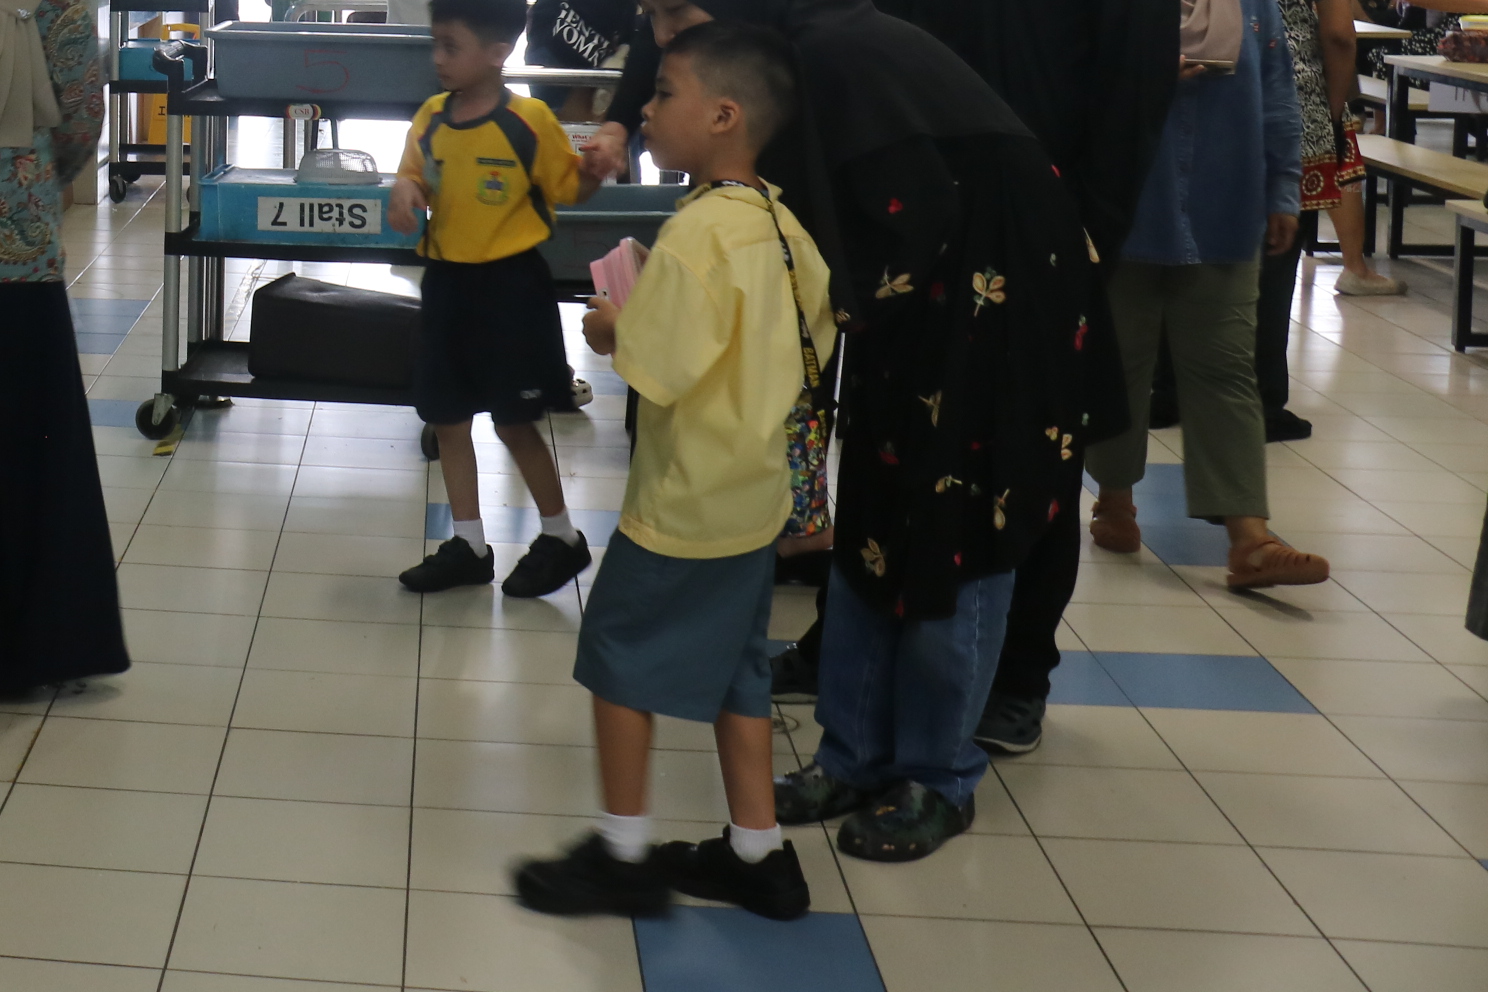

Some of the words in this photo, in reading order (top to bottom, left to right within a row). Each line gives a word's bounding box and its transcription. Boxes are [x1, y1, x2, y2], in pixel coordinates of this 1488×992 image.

[296, 49, 350, 94] 5
[294, 107, 310, 115] CSB
[271, 202, 287, 226] 7
[299, 202, 368, 229] Stall
